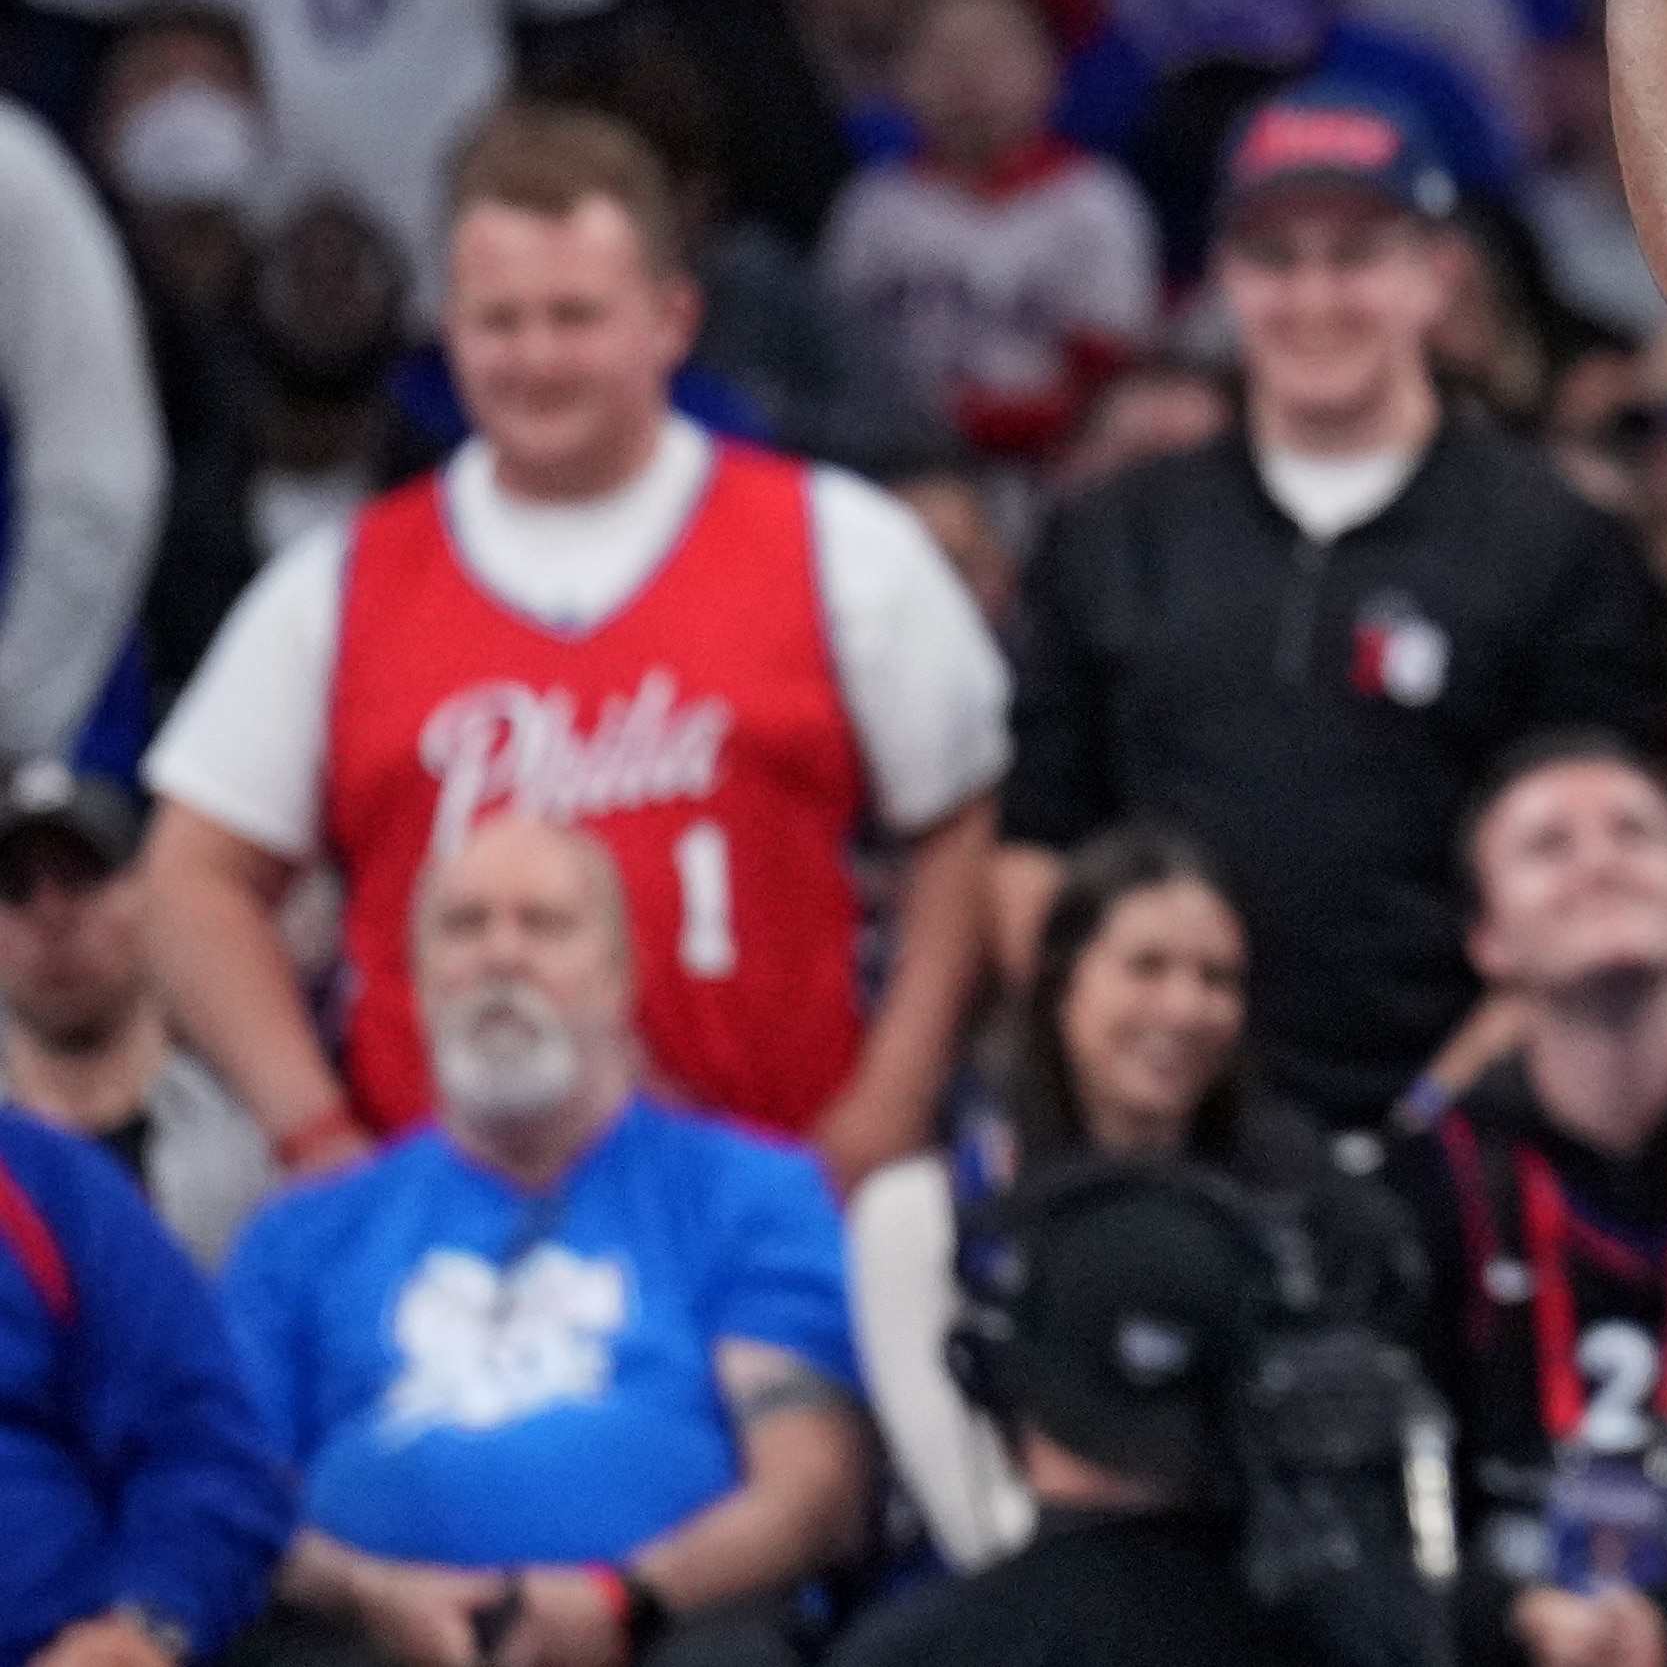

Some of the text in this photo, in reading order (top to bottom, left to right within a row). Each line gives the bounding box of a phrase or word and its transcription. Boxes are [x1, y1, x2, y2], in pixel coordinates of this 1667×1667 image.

[418, 666, 736, 860] Phila
[673, 820, 739, 979] 1
[1576, 1317, 1662, 1454] 2
